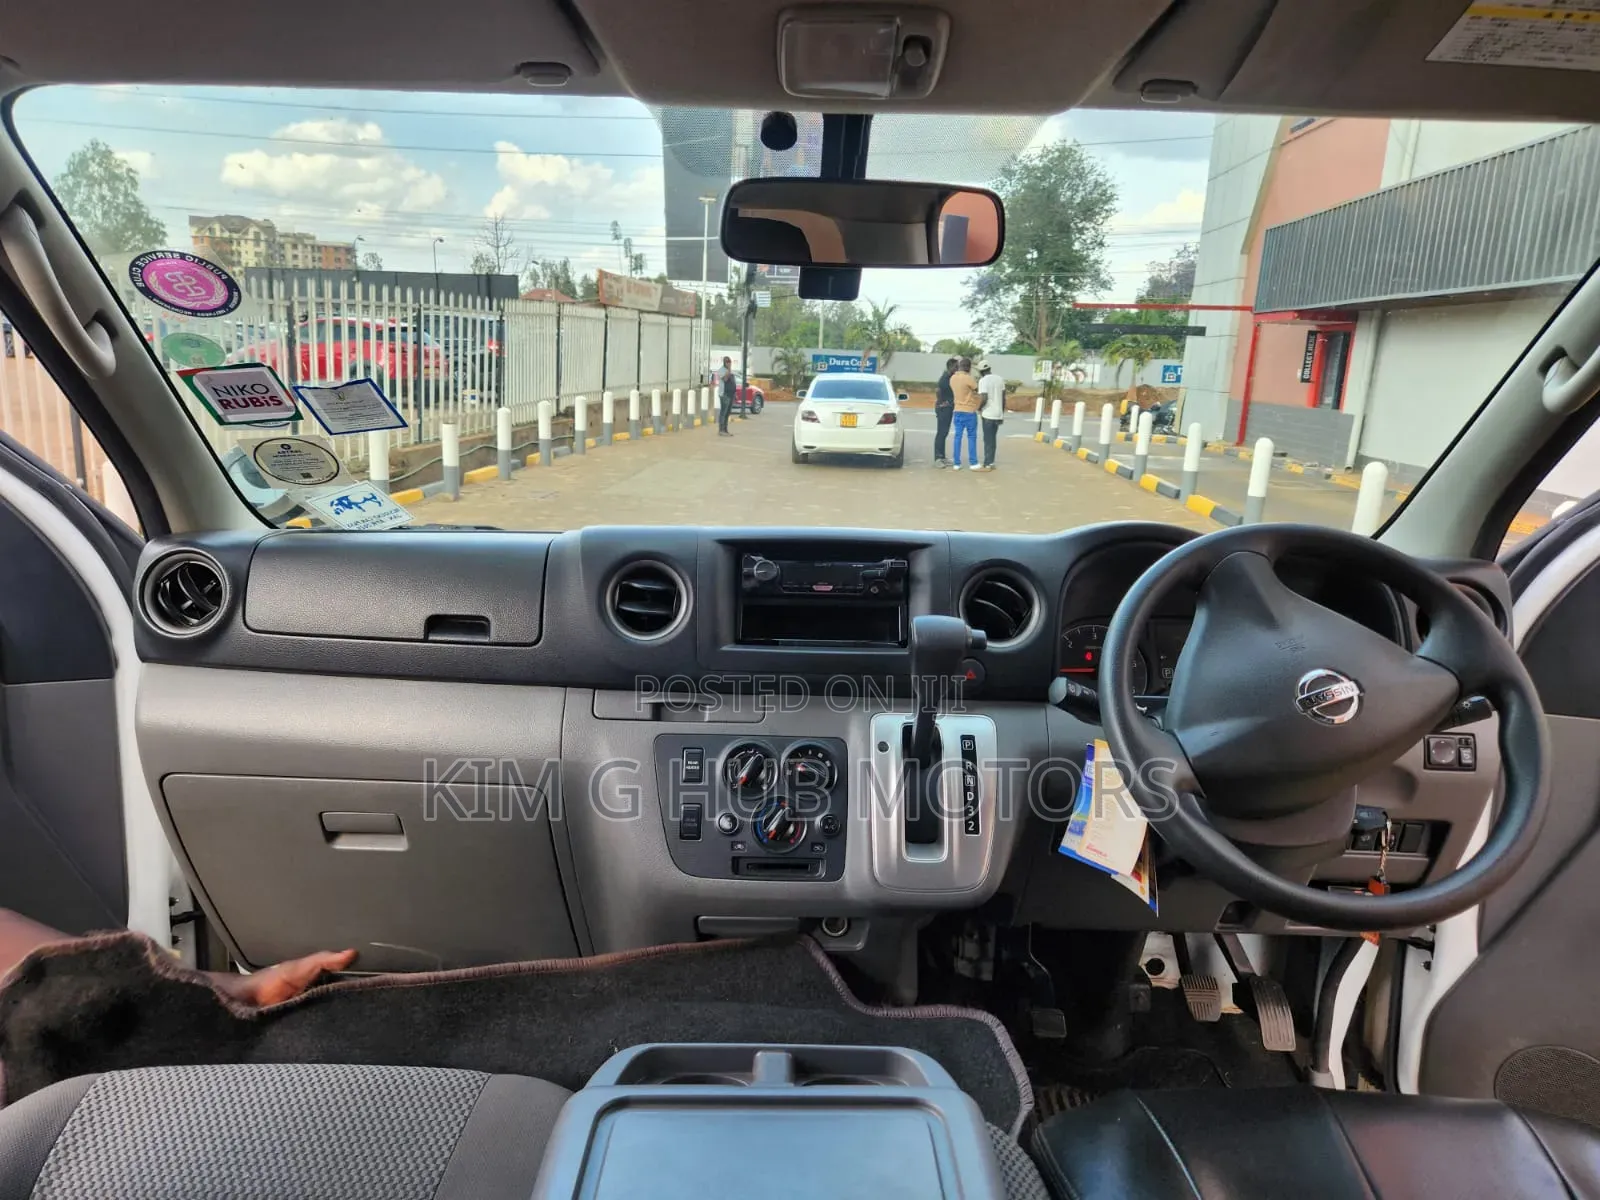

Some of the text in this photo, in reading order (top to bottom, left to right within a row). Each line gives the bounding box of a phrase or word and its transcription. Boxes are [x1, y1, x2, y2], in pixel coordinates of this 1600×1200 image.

[1303, 353, 1313, 379] COLLECT
[212, 383, 270, 397] NIKO
[965, 761, 973, 770] R
[967, 792, 974, 801] D
[968, 806, 975, 817] 3
[968, 821, 975, 831] 2
